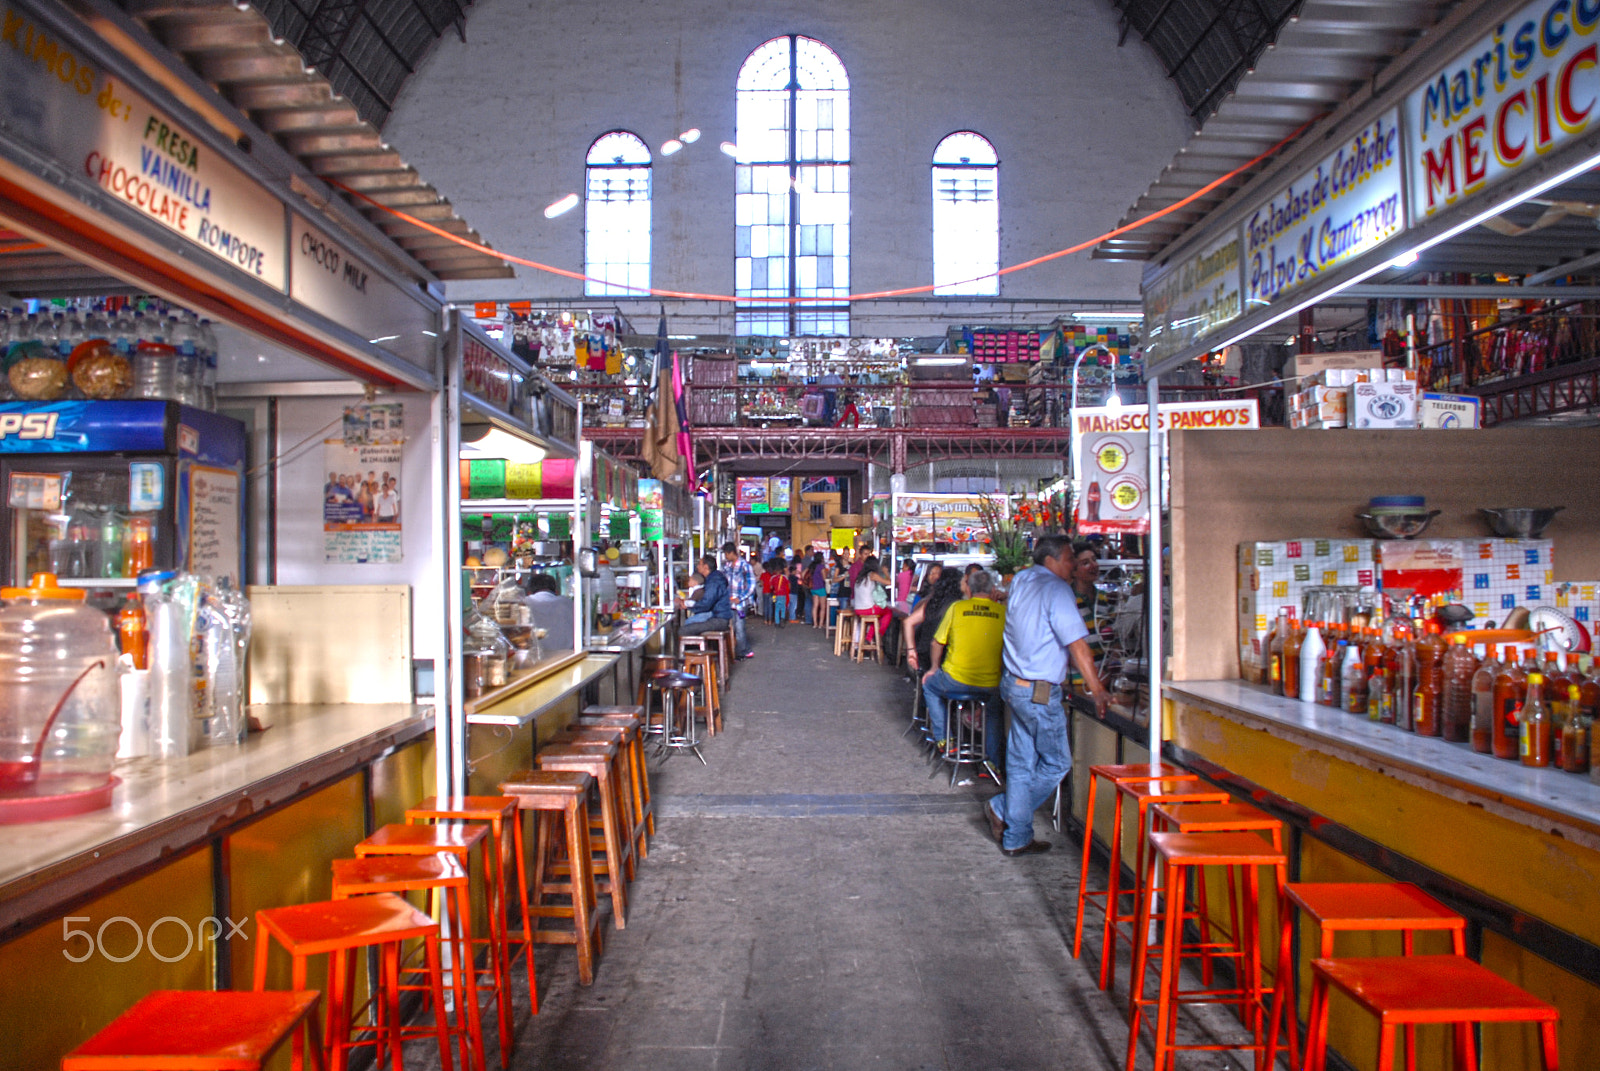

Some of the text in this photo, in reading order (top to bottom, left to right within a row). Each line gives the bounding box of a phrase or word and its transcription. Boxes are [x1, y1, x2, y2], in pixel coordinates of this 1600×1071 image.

[2, 9, 96, 95] KIMOS
[144, 116, 199, 174] FRESA
[1421, 41, 1598, 216] MECIC
[84, 150, 265, 275] CHOCOLATE ROMPOPE
[141, 144, 212, 215] VAINILLA
[1247, 186, 1310, 257] Tostadas
[301, 231, 369, 296] CHOCO MILK
[1170, 408, 1251, 430] PANCHO'S
[1432, 402, 1467, 411] TELEFONO
